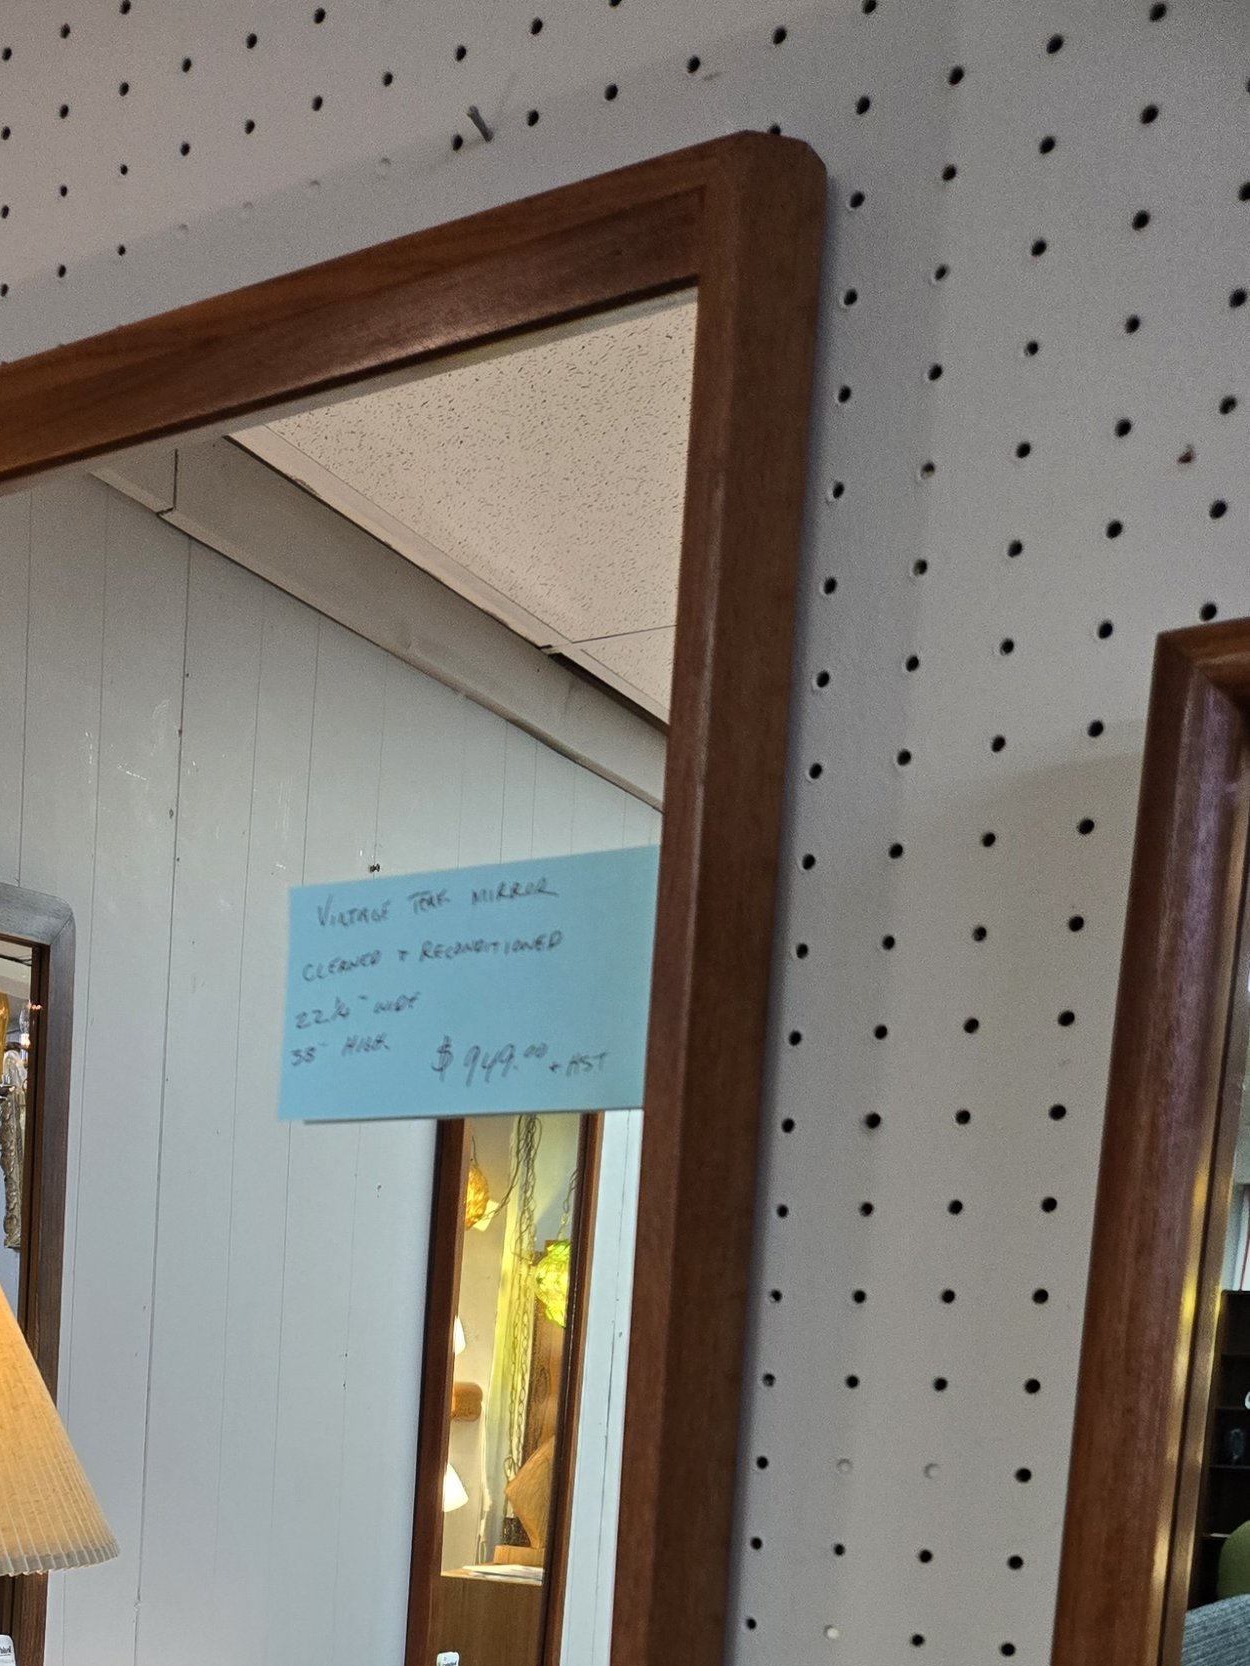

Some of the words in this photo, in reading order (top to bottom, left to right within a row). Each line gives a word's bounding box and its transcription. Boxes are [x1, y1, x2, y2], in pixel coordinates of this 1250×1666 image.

[317, 893, 391, 929] VINTAGE
[408, 887, 451, 915] TEAK
[471, 877, 559, 906] MIRROR
[302, 949, 382, 982] CLEANED
[419, 929, 563, 963] RECONDITIONED
[565, 1052, 609, 1077] HST
